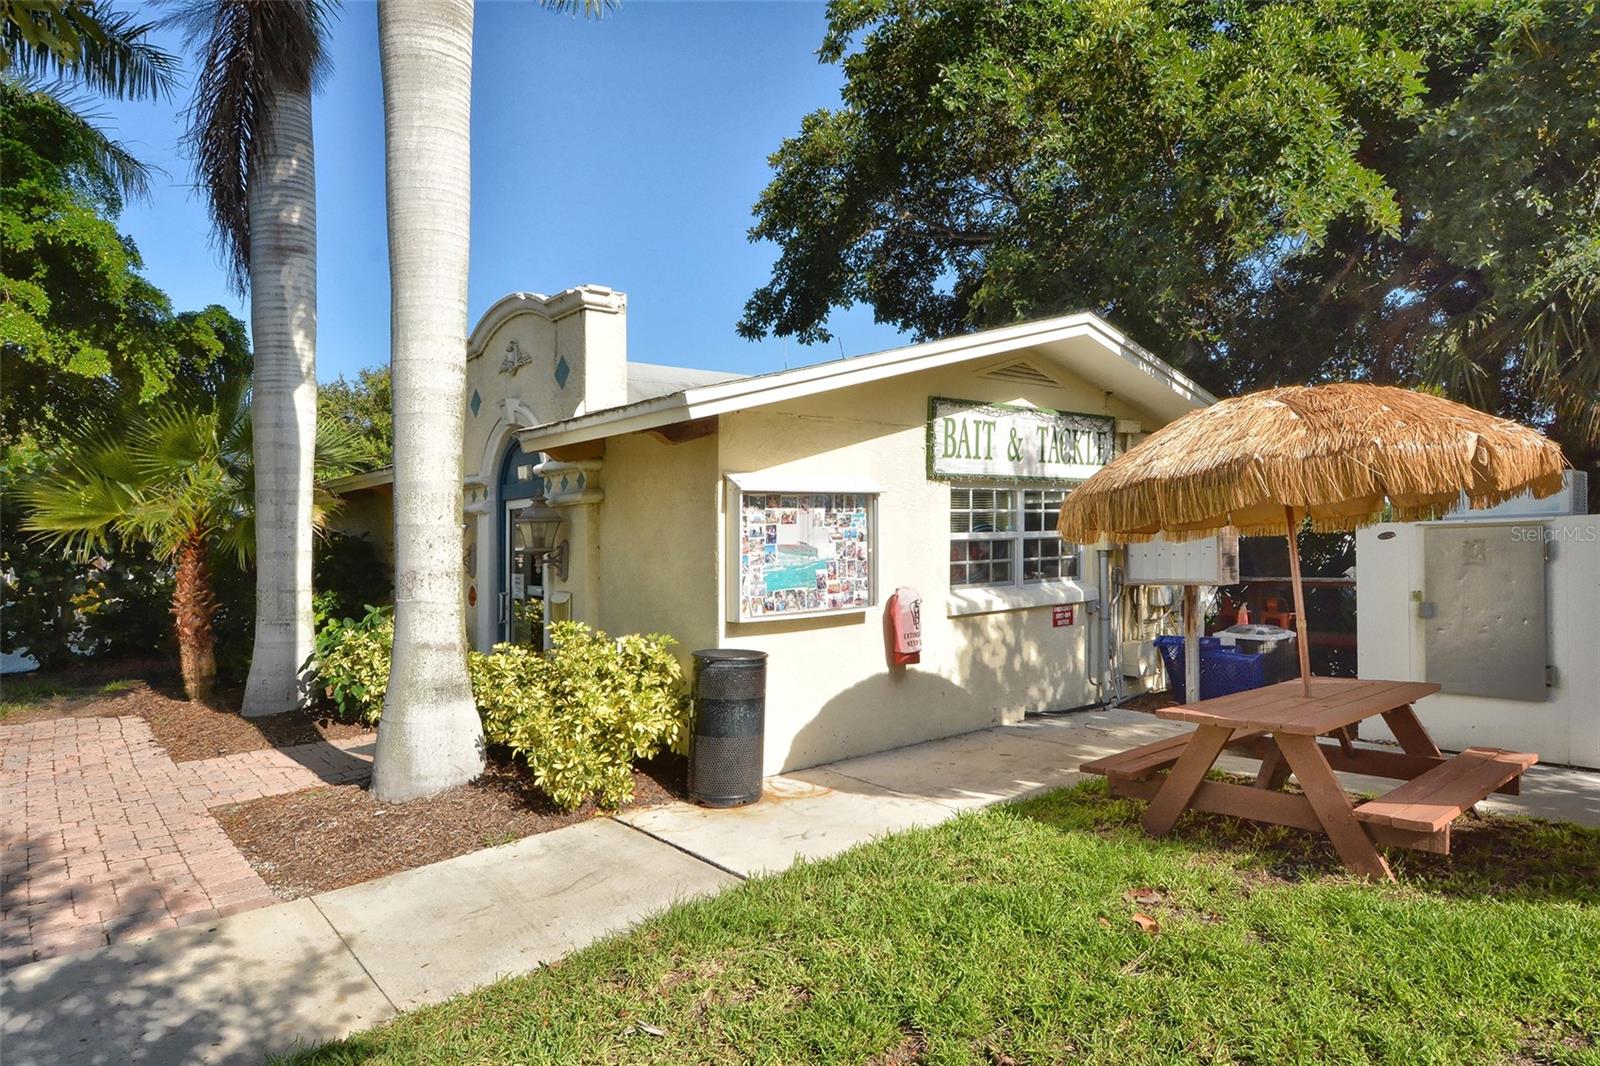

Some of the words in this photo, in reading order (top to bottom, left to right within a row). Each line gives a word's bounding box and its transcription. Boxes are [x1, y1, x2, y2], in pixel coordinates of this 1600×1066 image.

[942, 417, 996, 460] BAIT
[1007, 426, 1023, 463] &
[1036, 425, 1107, 466] TACKLE
